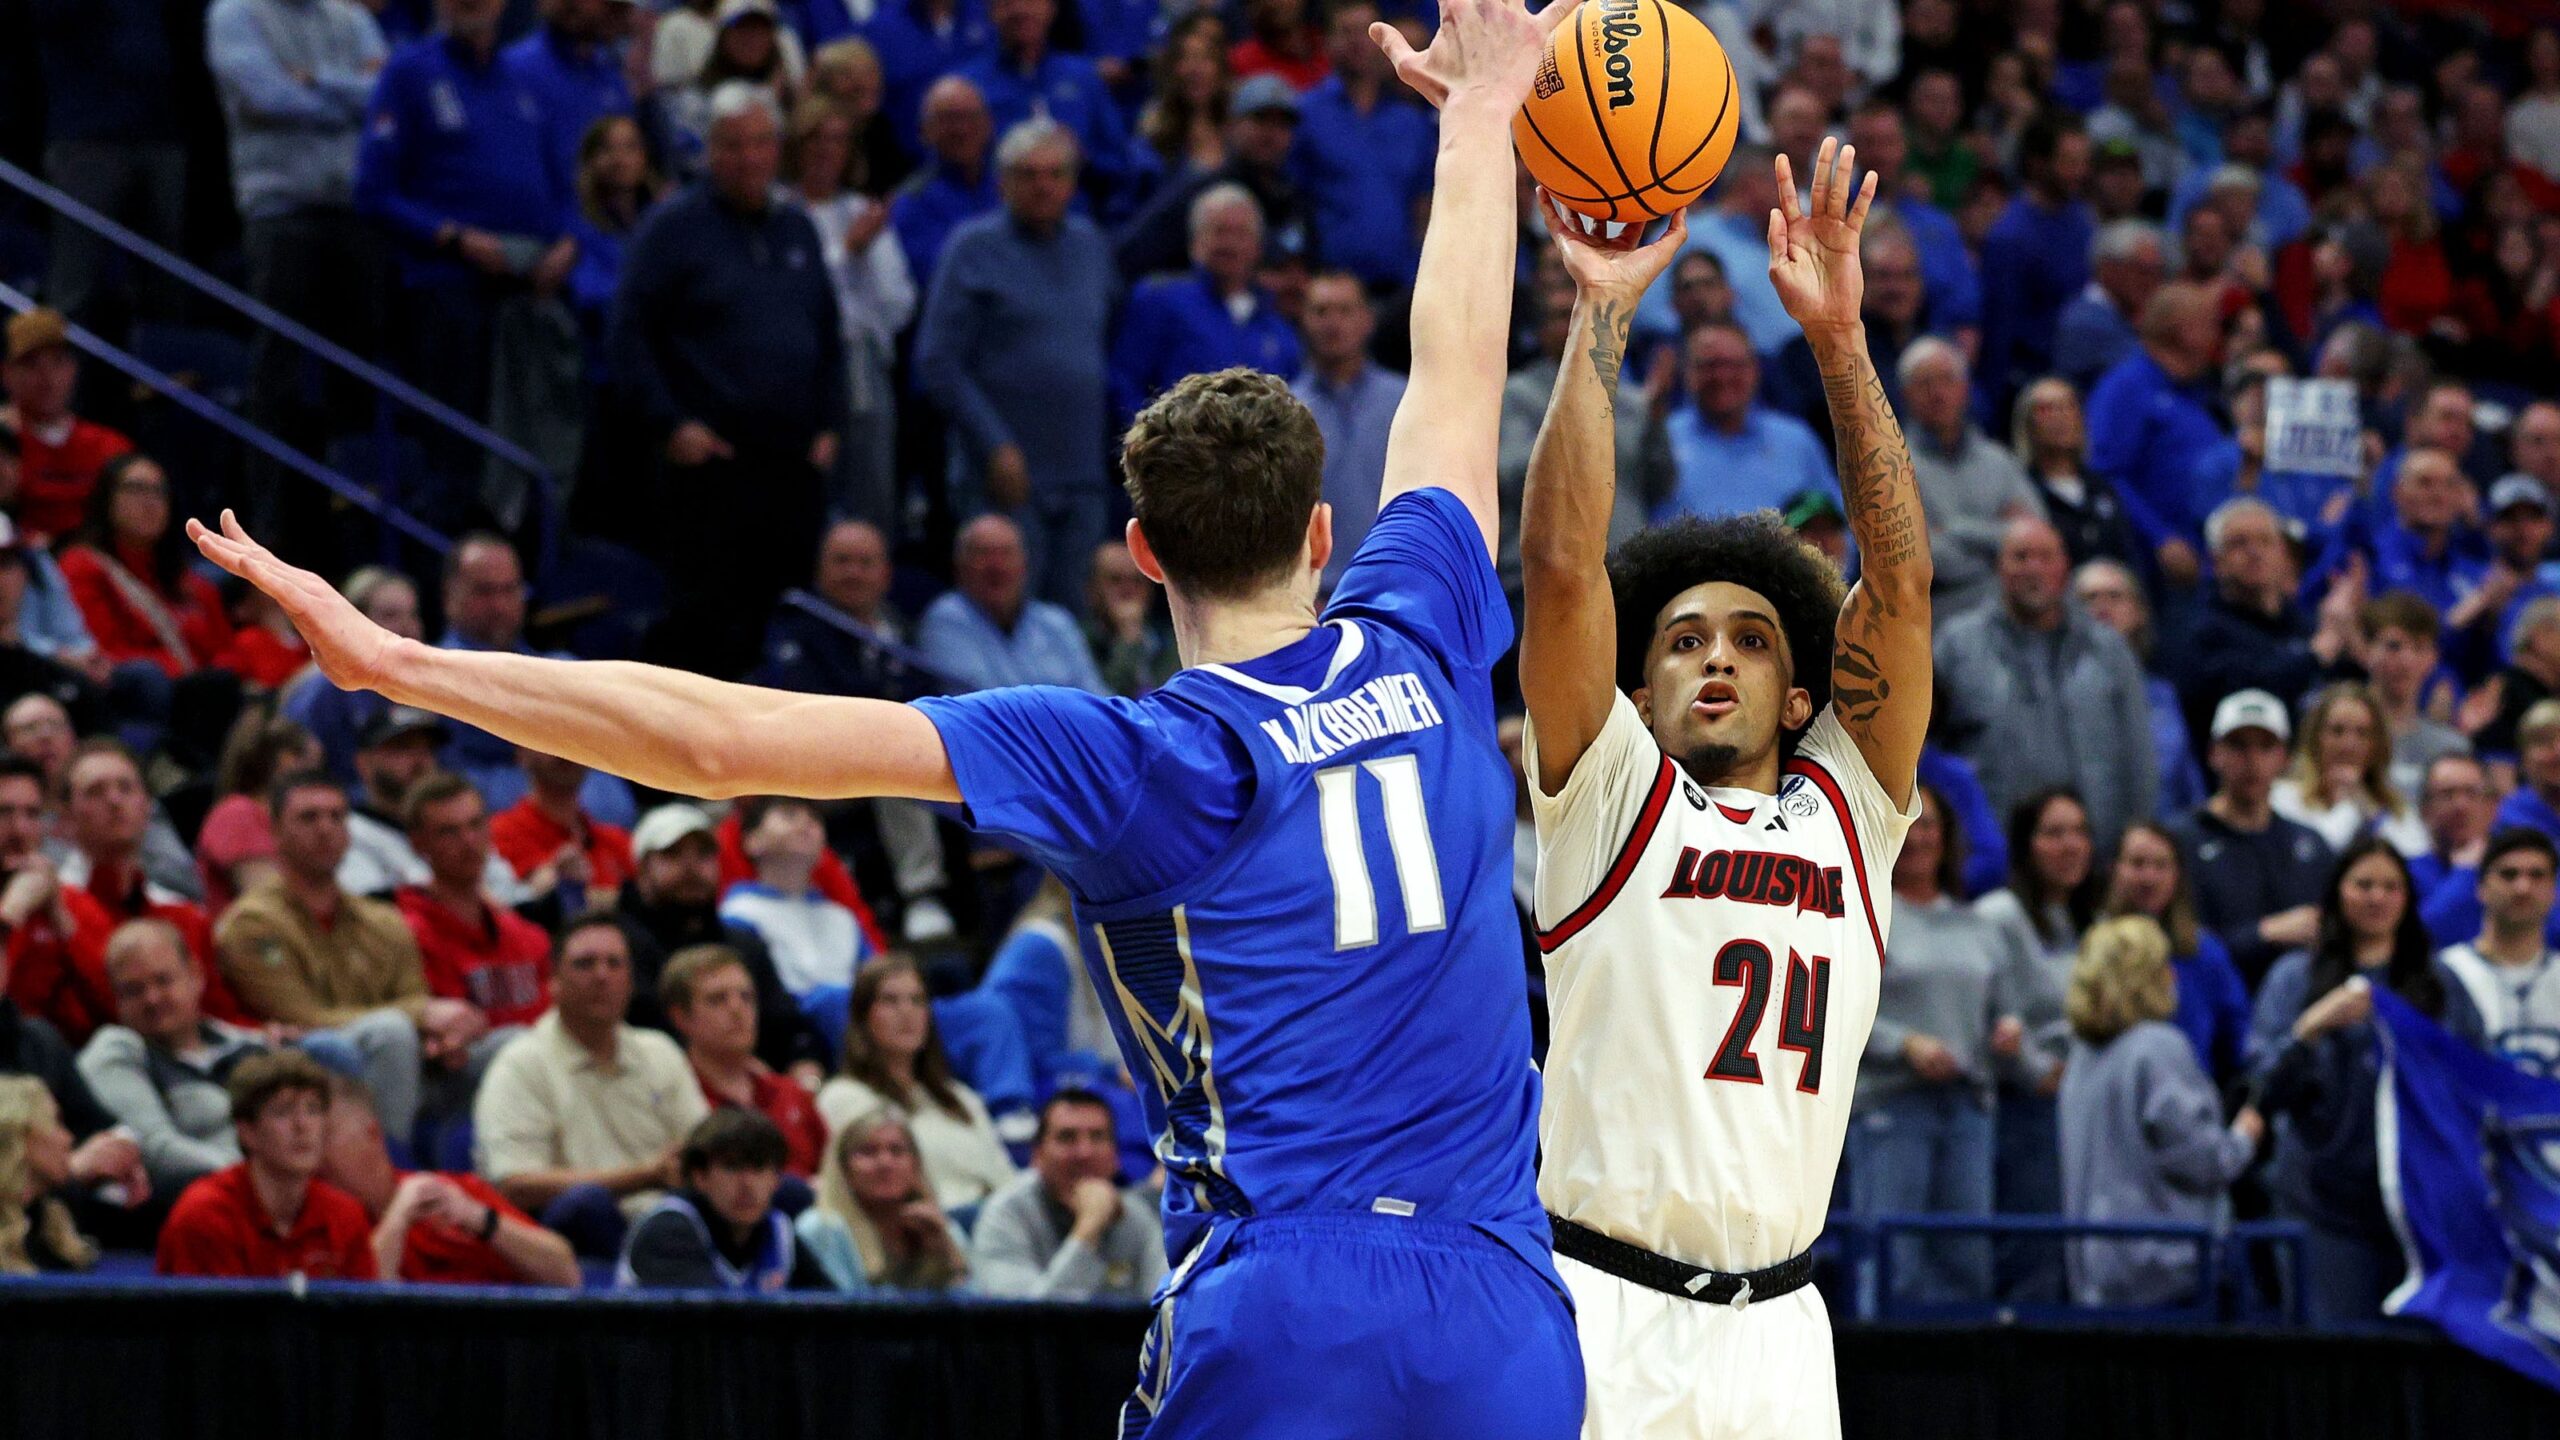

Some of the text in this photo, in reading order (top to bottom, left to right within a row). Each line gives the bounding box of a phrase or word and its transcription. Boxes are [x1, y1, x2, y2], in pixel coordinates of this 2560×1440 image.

[1593, 38, 1601, 58] NXT
[1314, 754, 1447, 951] 11
[1703, 938, 1831, 1095] 24
